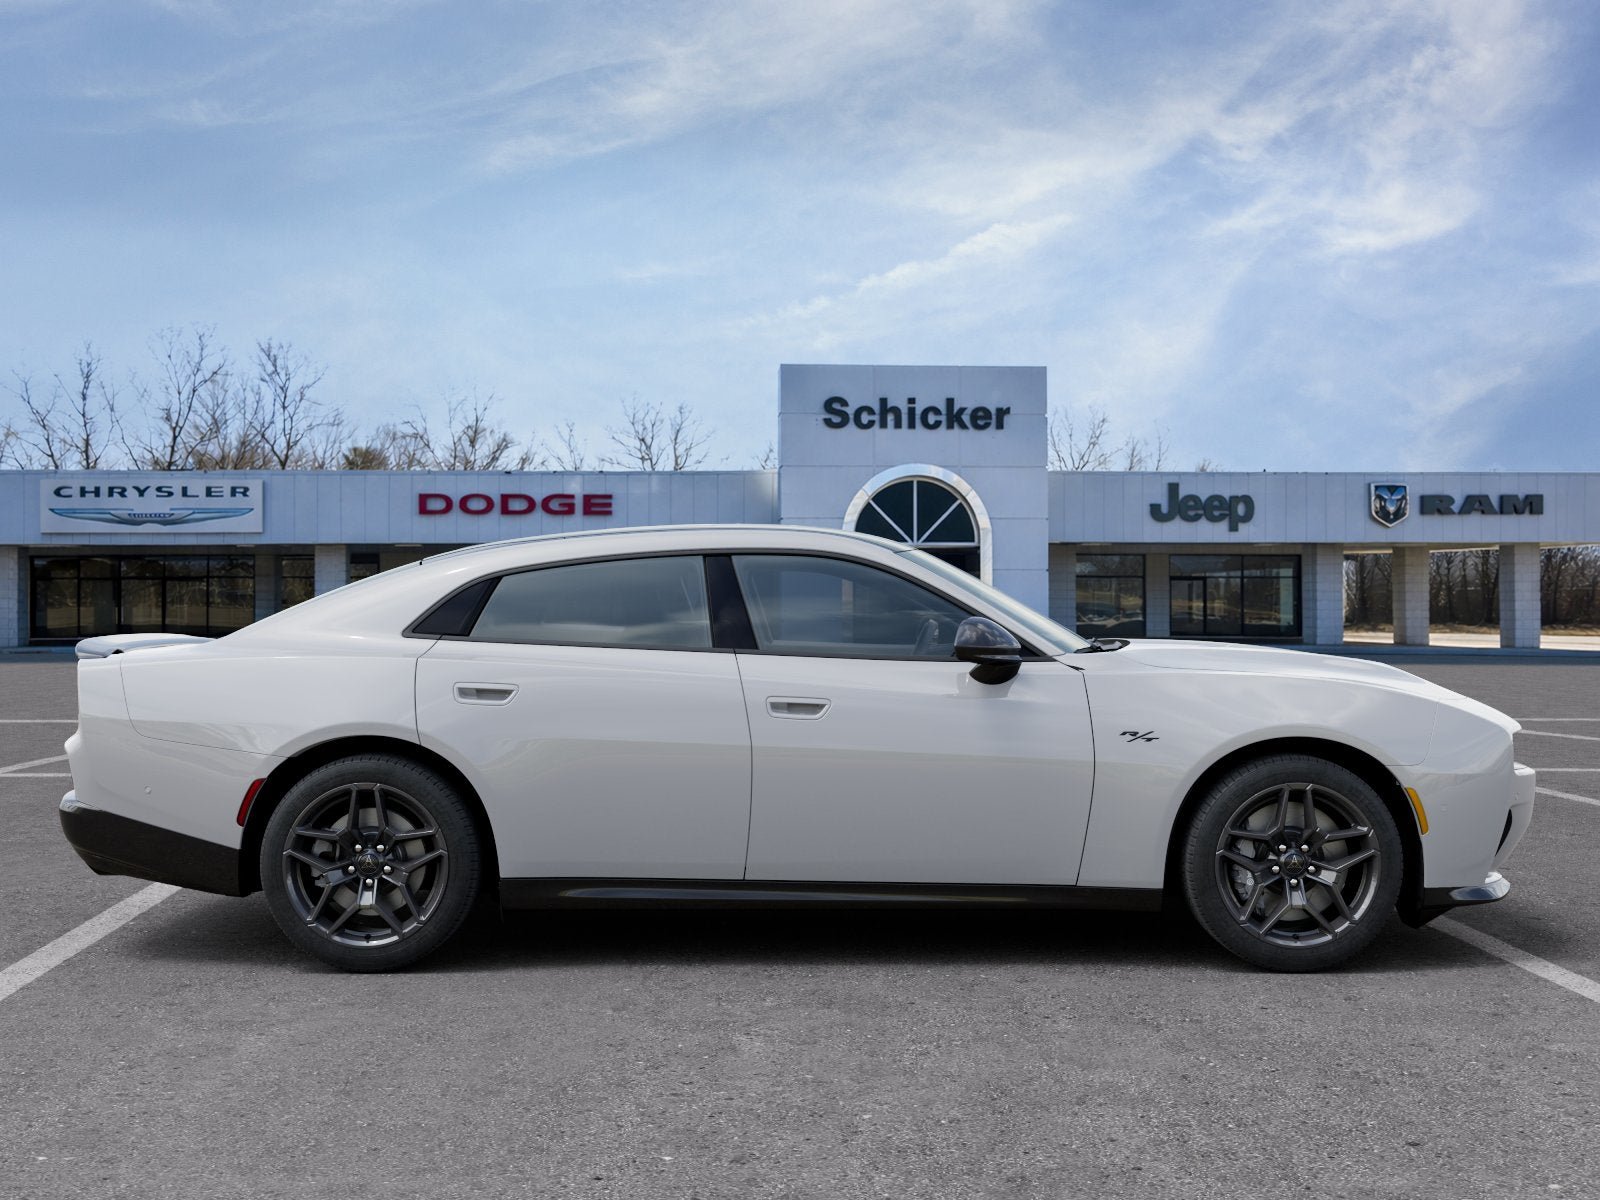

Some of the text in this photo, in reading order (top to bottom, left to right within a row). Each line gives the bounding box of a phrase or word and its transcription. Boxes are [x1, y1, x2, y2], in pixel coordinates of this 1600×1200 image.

[823, 396, 1011, 430] Schicker
[53, 485, 250, 499] CHRYSLER
[418, 494, 614, 516] DODGE
[1149, 482, 1255, 532] Jeep
[1419, 494, 1545, 516] RAM
[1119, 730, 1160, 743] R/T
